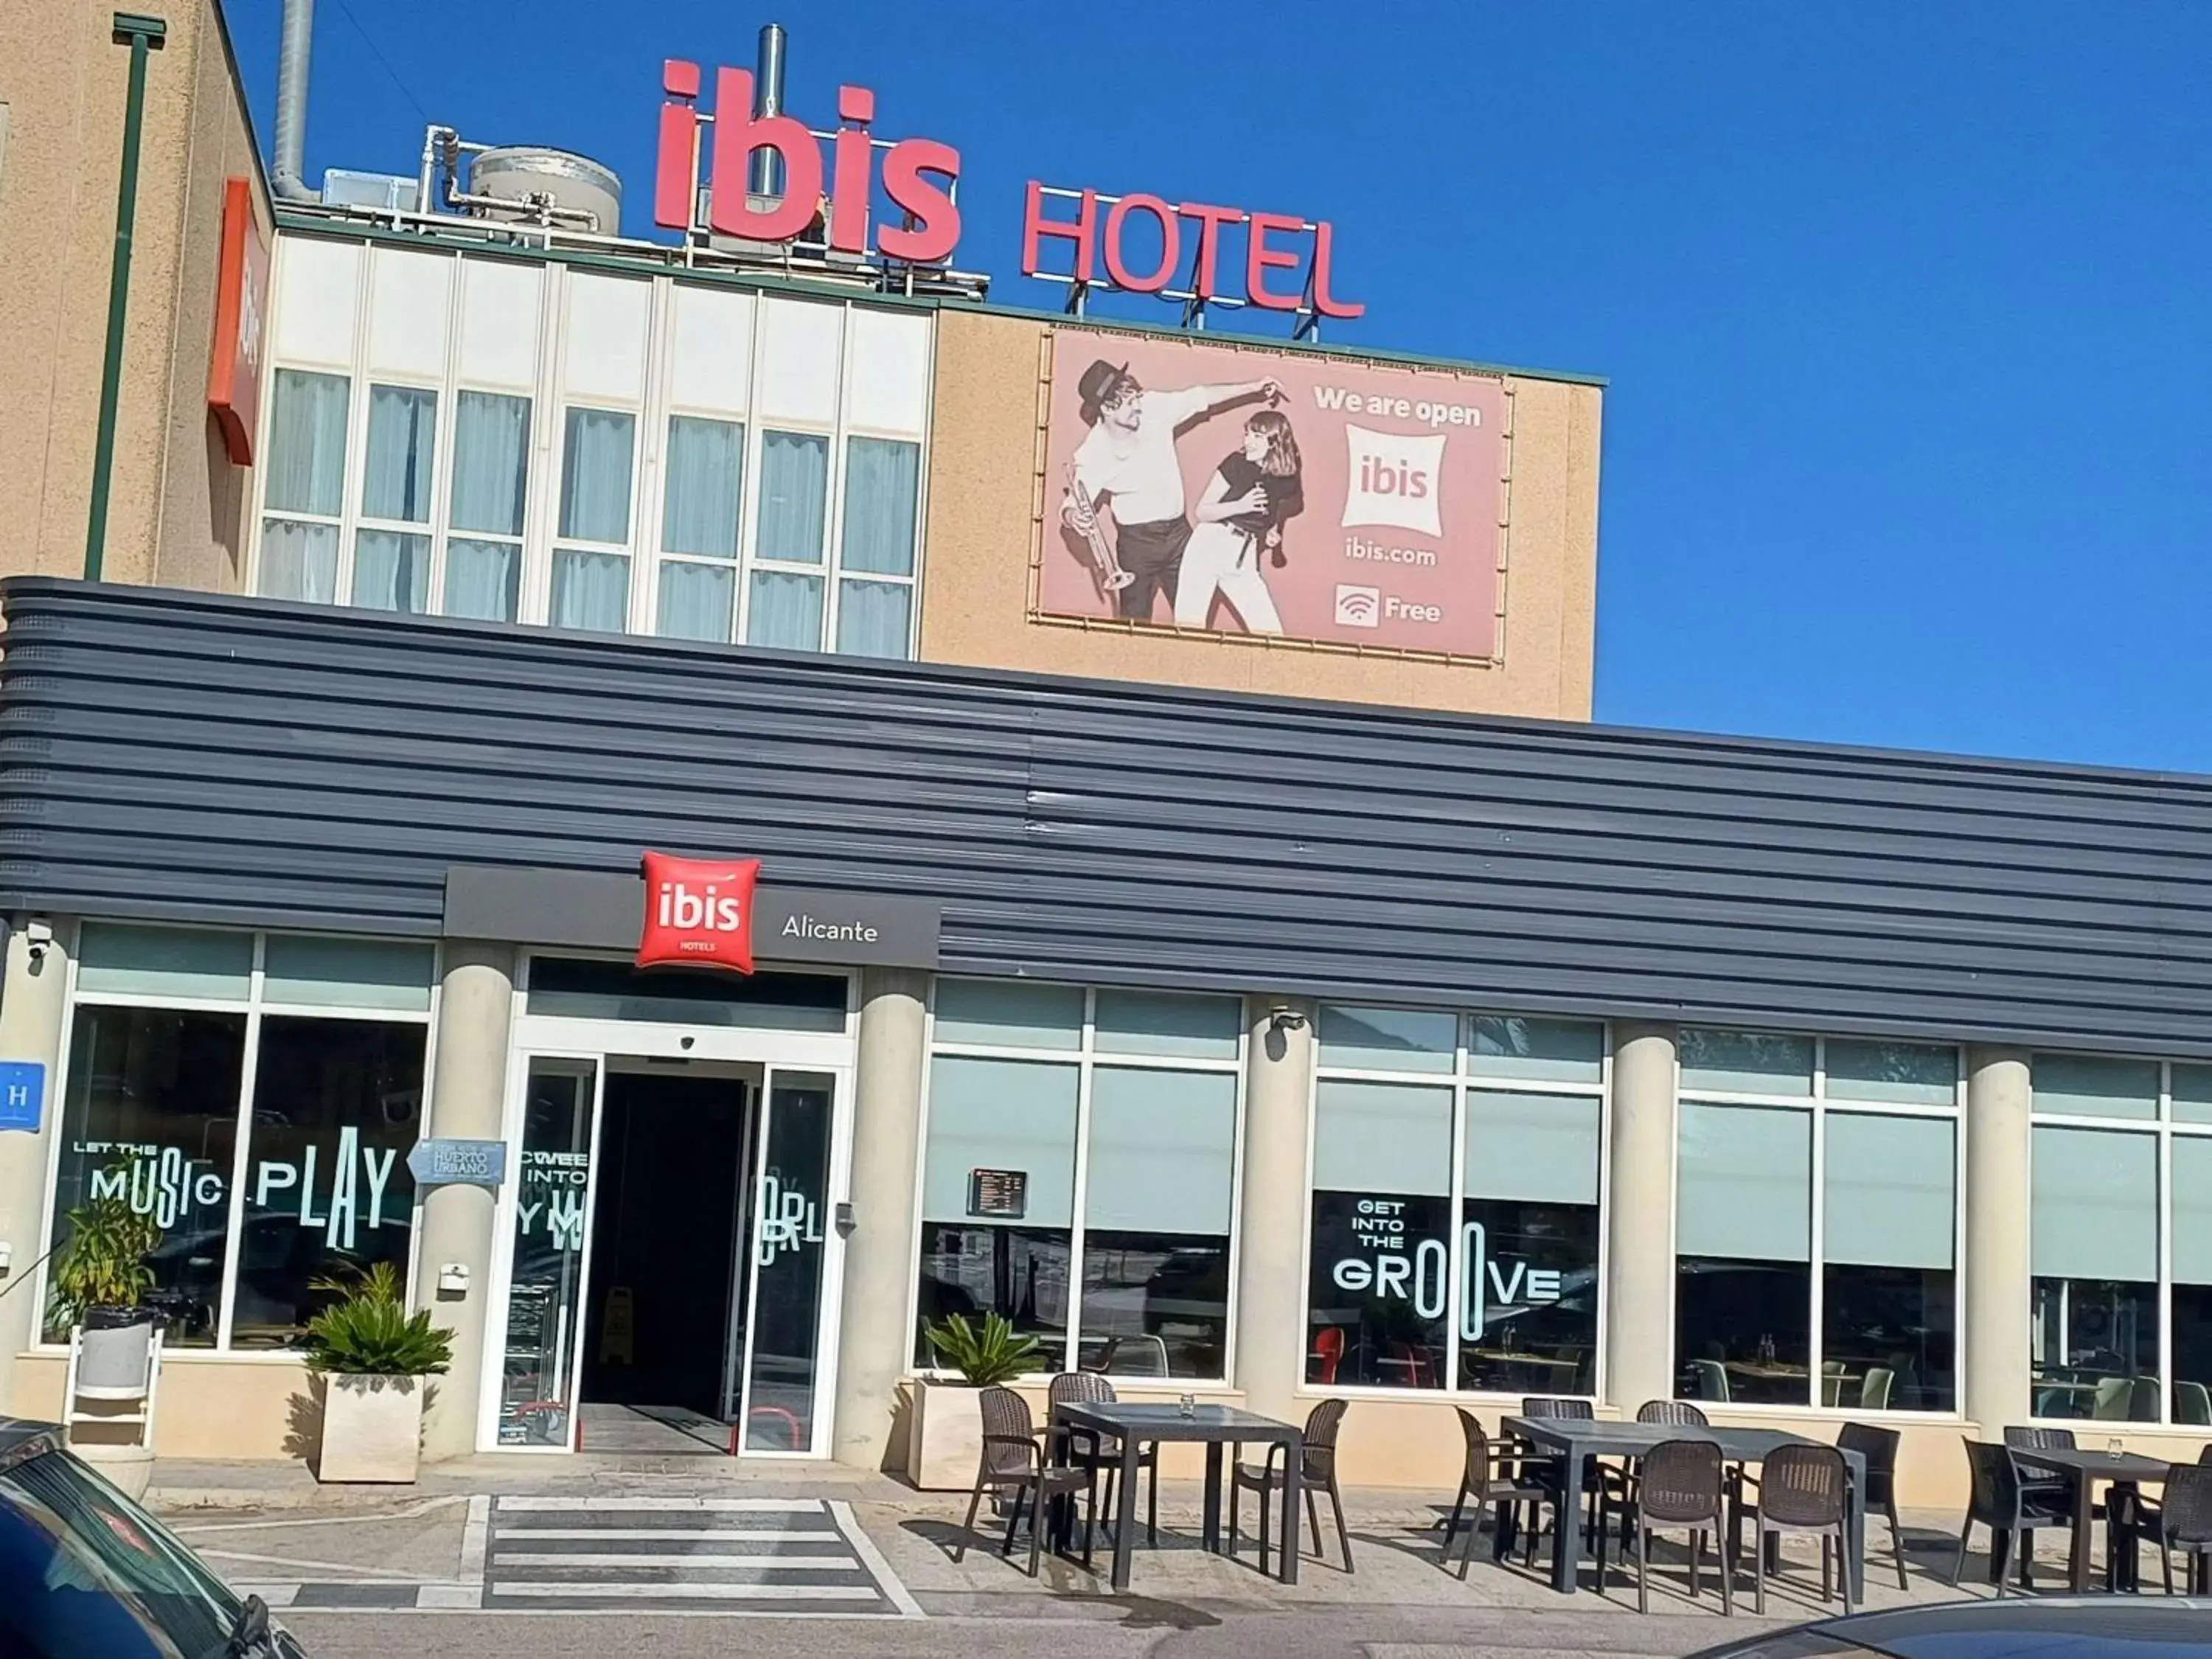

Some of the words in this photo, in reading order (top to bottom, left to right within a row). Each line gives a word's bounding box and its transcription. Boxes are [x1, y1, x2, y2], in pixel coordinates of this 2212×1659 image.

[654, 58, 961, 263] ibis
[1020, 179, 1366, 319] HOTEL
[1313, 384, 1363, 412] We
[1366, 395, 1411, 419] are
[1415, 401, 1482, 428] open
[1360, 454, 1429, 499] ibis
[1345, 536, 1438, 567] ibis.com
[1384, 597, 1442, 623] Free
[658, 882, 741, 931] ibis
[781, 915, 880, 942] Alicante
[680, 942, 717, 953] HOTELS
[8, 1085, 27, 1107] H
[74, 1141, 112, 1153] LET
[115, 1144, 158, 1156] THE
[90, 1147, 223, 1229] MUSIC
[256, 1126, 397, 1249] PLAY
[527, 1169, 587, 1185] INTO
[1357, 1200, 1405, 1215] GET
[1352, 1217, 1404, 1232] INTO
[1358, 1234, 1404, 1248] THE
[1333, 1221, 1561, 1341] GROOVE
